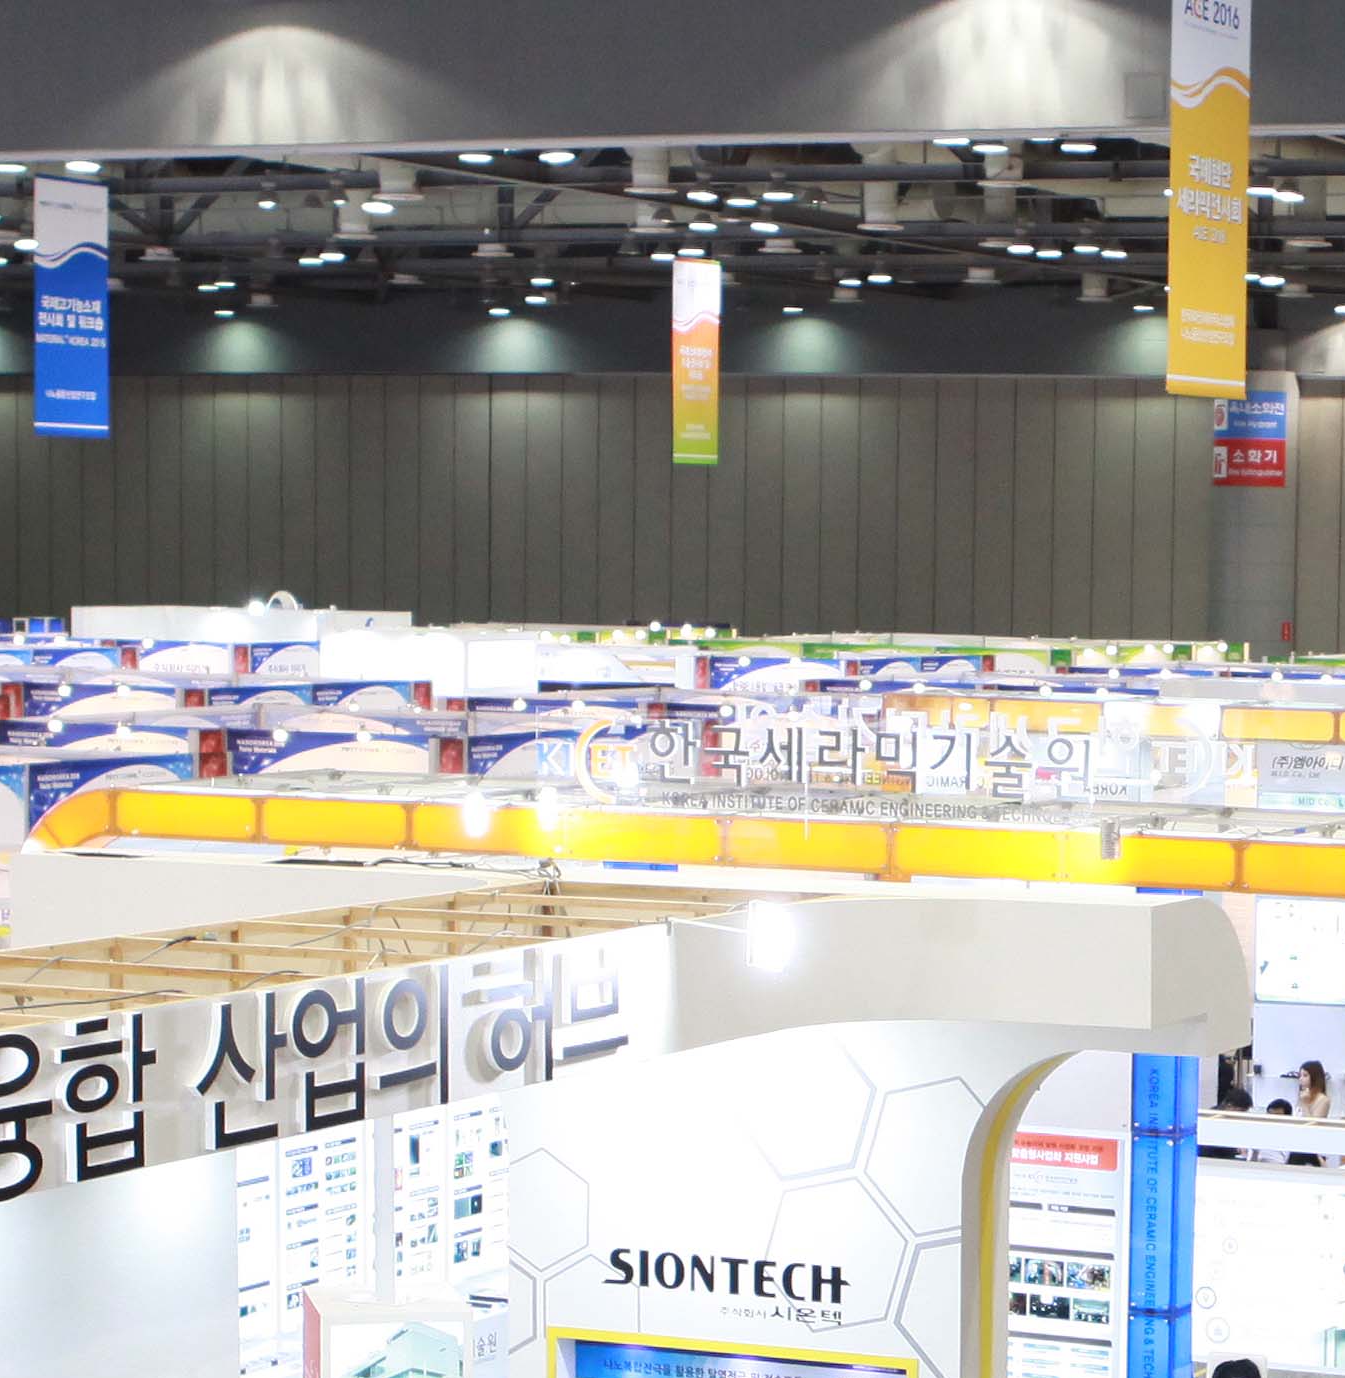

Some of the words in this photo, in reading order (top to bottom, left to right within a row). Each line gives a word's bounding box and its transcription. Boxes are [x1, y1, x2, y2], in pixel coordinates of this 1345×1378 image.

[1213, 1, 1240, 29] 2016
[1232, 449, 1278, 463] 소화기
[649, 719, 1092, 798] 한국세라믹기술원
[662, 791, 704, 807] KOREA
[712, 792, 783, 811] INSTITUTE
[788, 795, 805, 811] OF
[811, 796, 875, 817] CERAMIC
[881, 801, 977, 820] ENGINEERING
[192, 963, 451, 1150] 산업의
[460, 946, 631, 1086] 허브
[1148, 1068, 1159, 1108] KOREA
[1146, 1112, 1158, 1175] INSITUTE
[1146, 1178, 1158, 1192] OF
[1145, 1196, 1158, 1251] CERAMIC
[603, 1248, 850, 1303] SIONTECH
[1144, 1254, 1157, 1335] ENGINEENG
[770, 1306, 842, 1326] 시온텍
